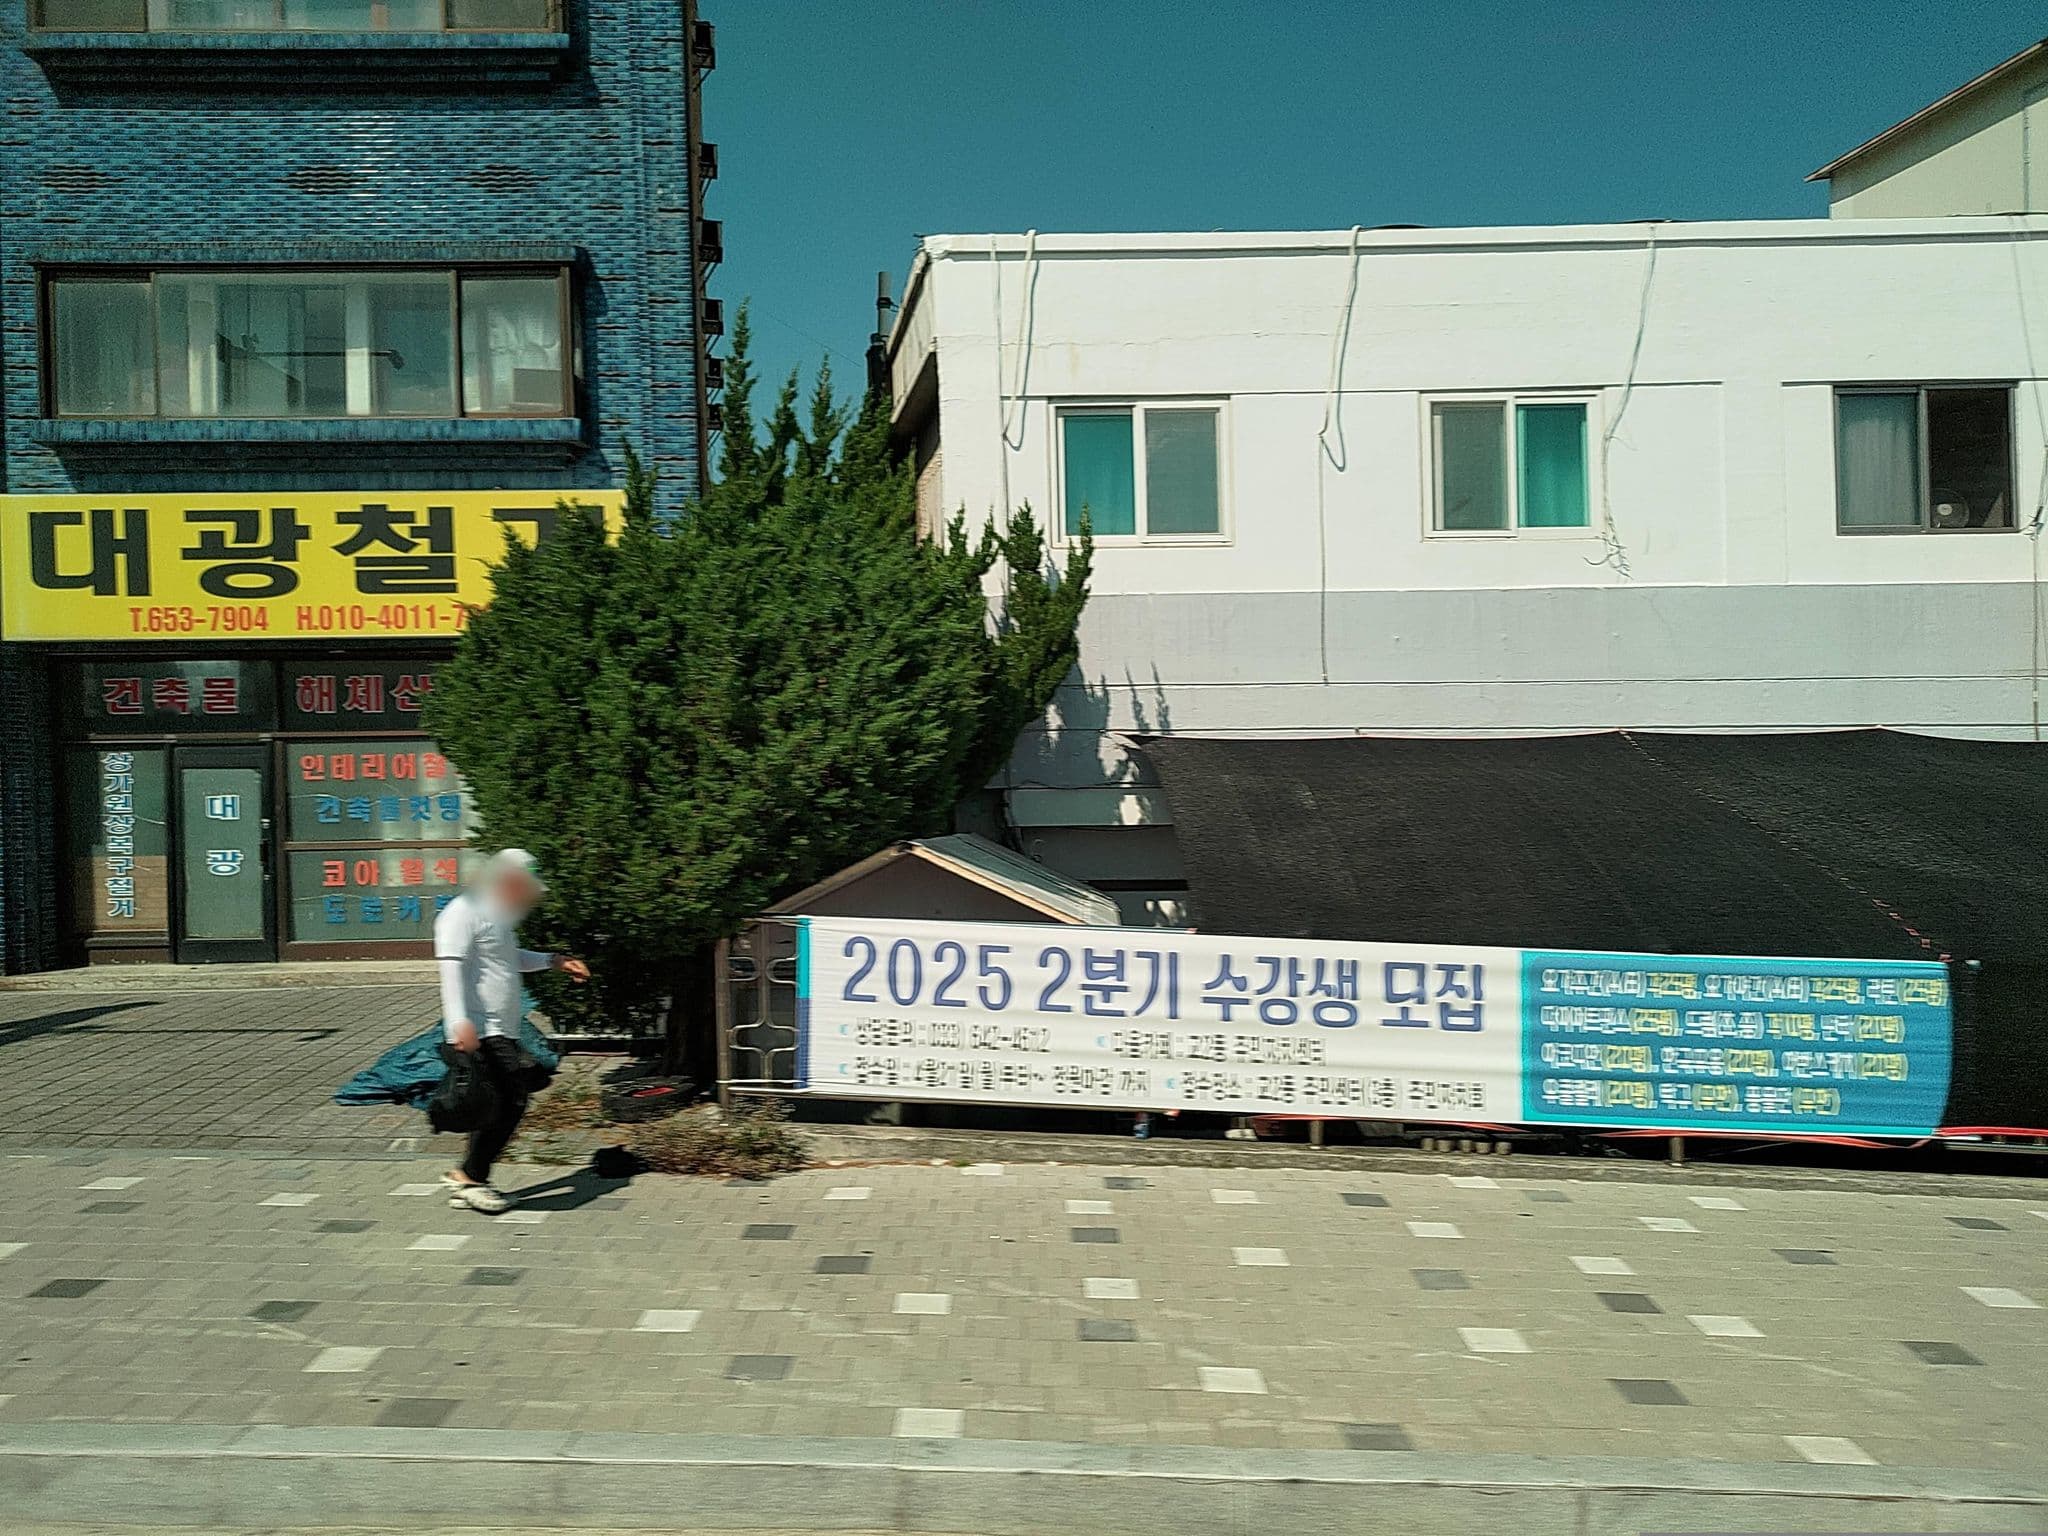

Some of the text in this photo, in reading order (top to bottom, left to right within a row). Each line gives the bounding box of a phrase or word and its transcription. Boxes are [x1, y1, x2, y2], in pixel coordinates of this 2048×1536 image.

[129, 605, 270, 633] T.653-7904
[296, 603, 486, 632] H.010-4011-7
[102, 676, 240, 715] 건축물
[101, 751, 135, 918] 상가원상복구철거
[843, 935, 1485, 1033] 2025 2분기 수강생 모집
